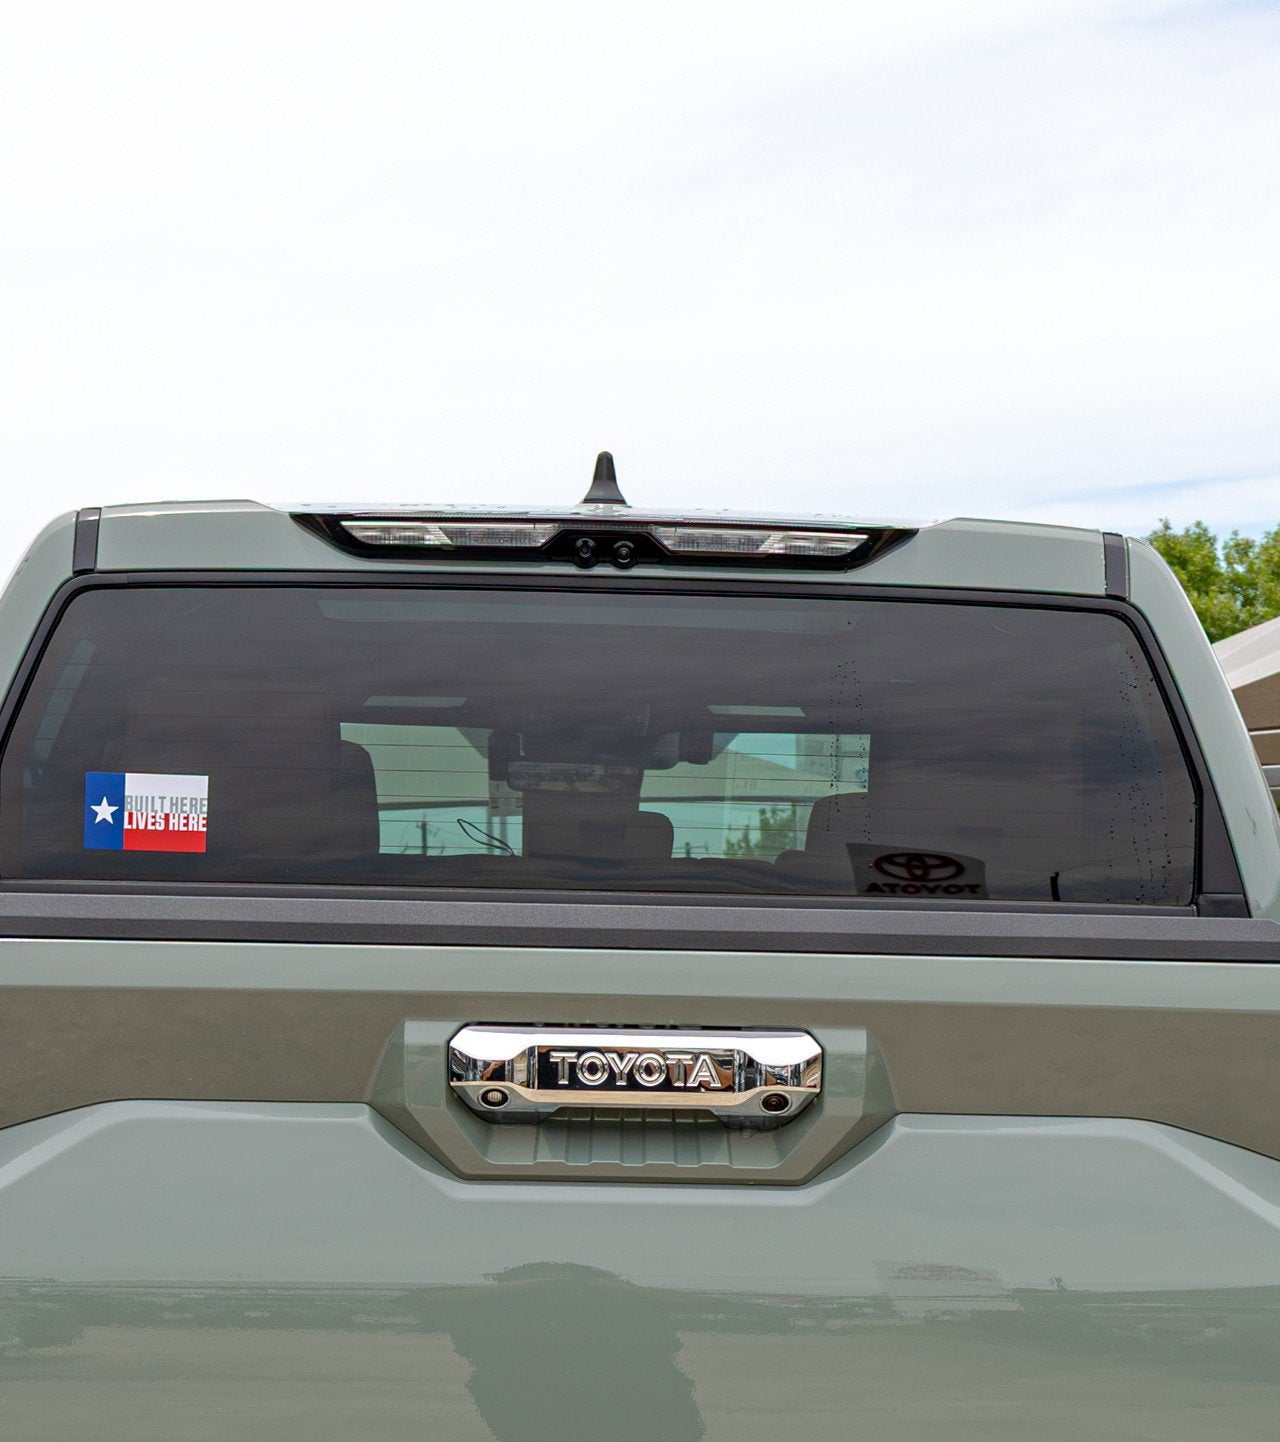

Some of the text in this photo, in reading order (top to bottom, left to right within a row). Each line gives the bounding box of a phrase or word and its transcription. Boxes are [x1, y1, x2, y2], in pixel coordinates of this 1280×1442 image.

[124, 795, 208, 814] BUILT HERE
[124, 812, 207, 832] LIVES HERE
[549, 1050, 722, 1087] TOYOTA
